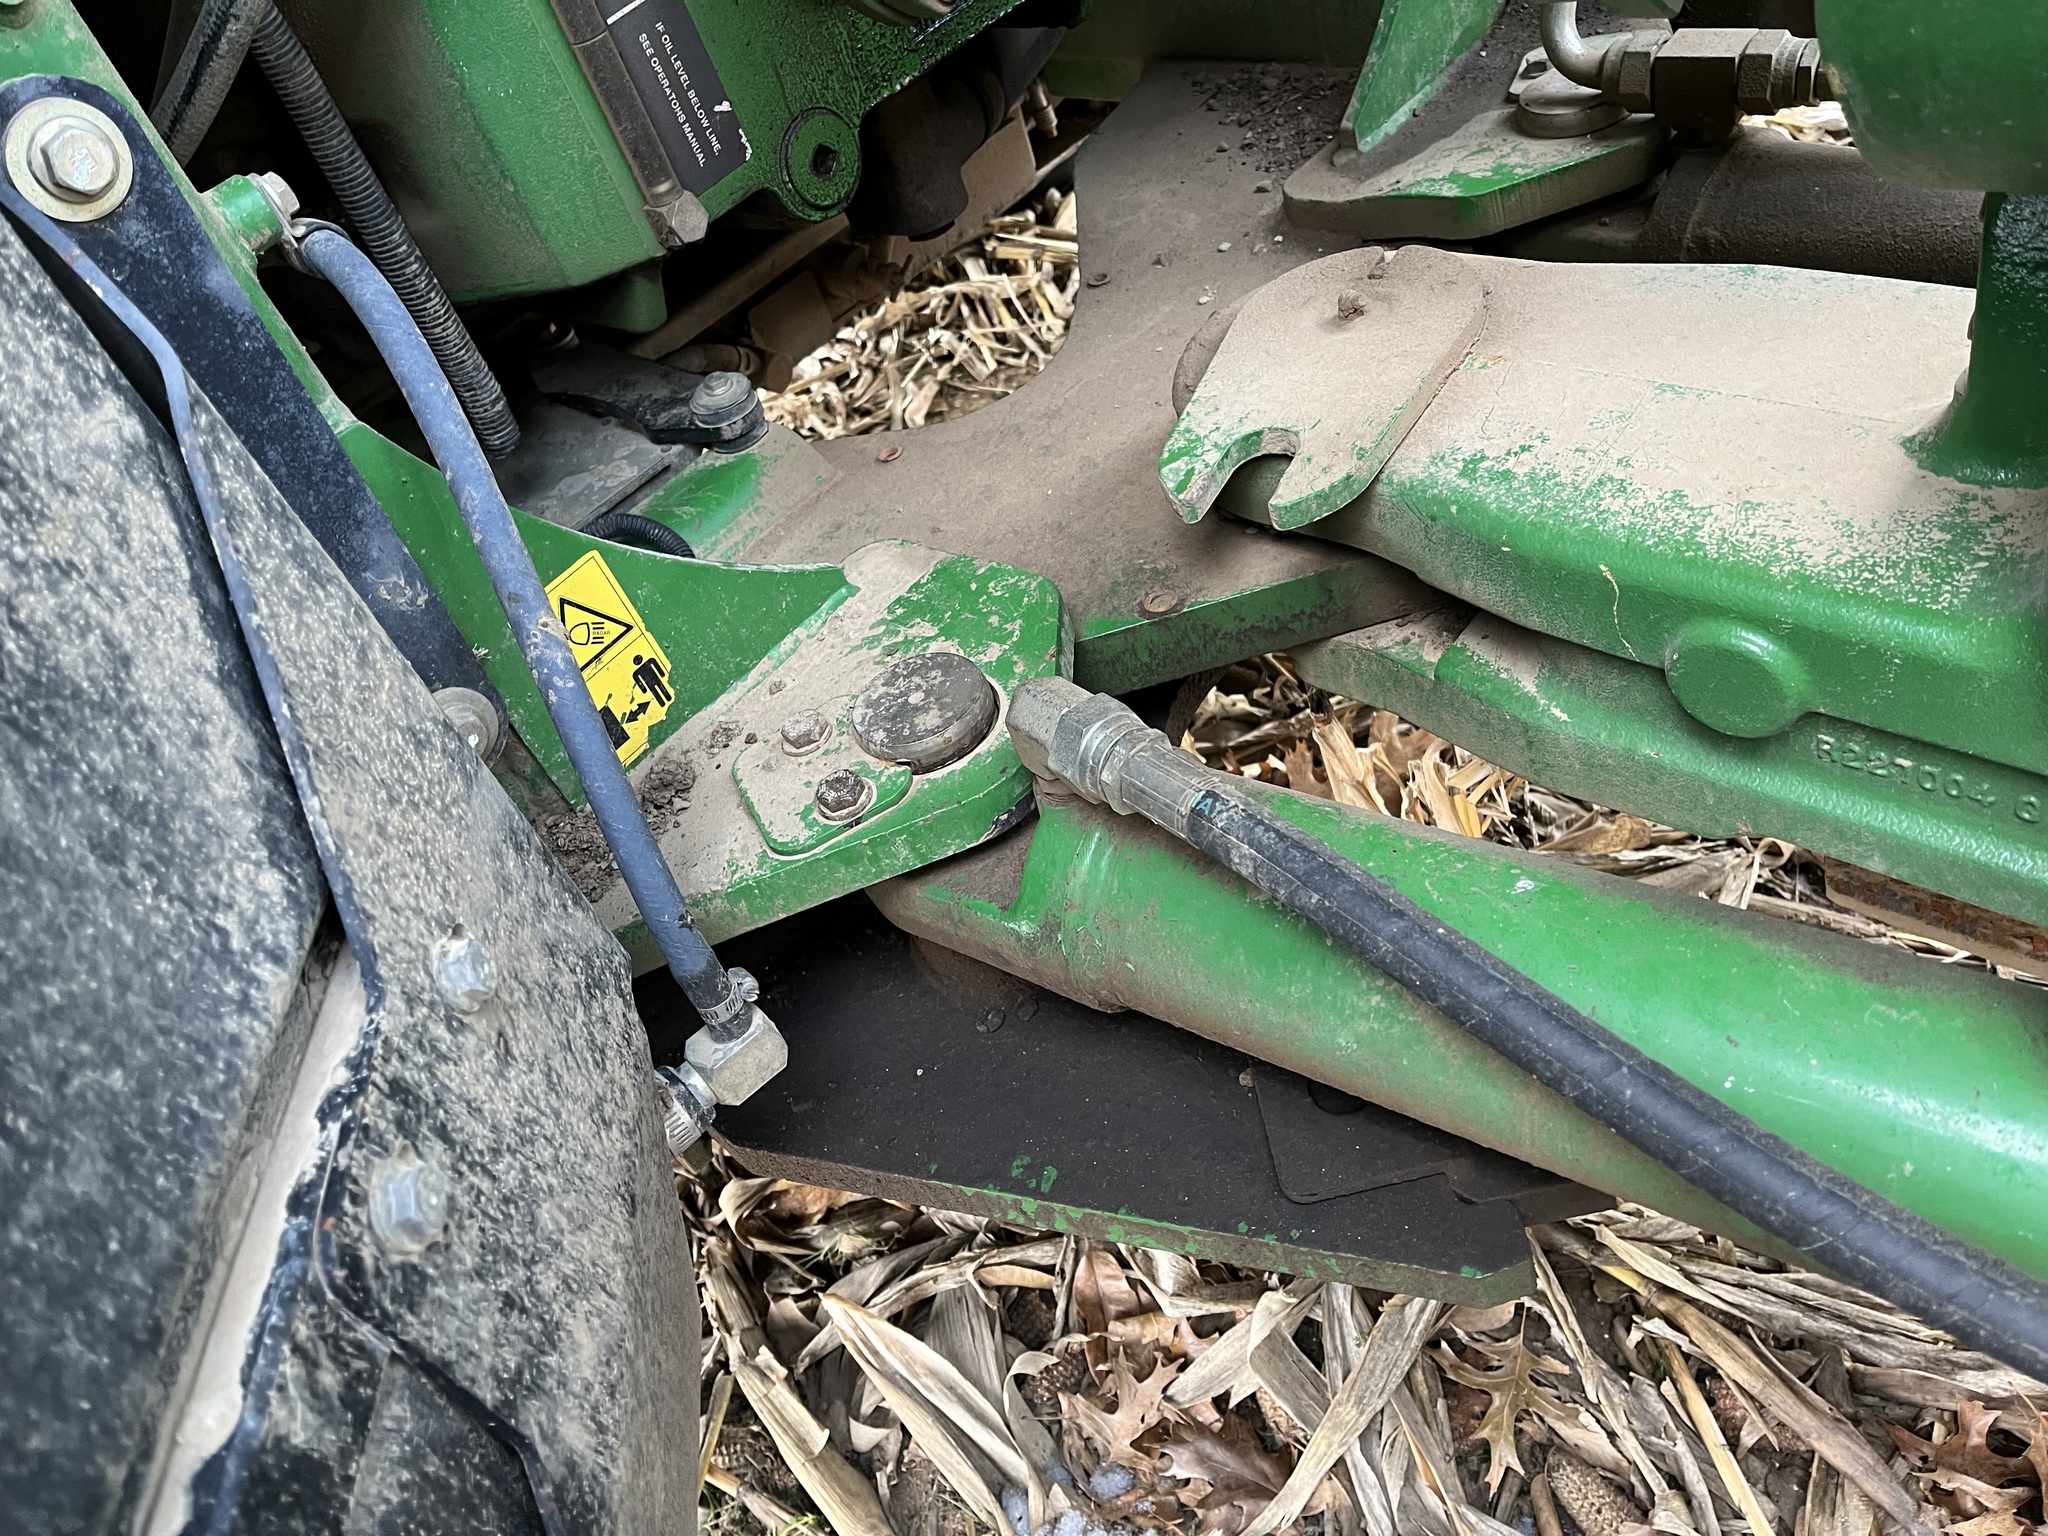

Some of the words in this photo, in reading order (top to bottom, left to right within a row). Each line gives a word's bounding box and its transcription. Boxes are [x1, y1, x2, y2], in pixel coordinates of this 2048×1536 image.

[638, 32, 654, 57] SEE
[682, 122, 706, 167] MANUAL
[655, 21, 666, 33] IF
[661, 34, 675, 55] OIL
[670, 54, 692, 90] LEVEL
[687, 89, 710, 128] BELOW
